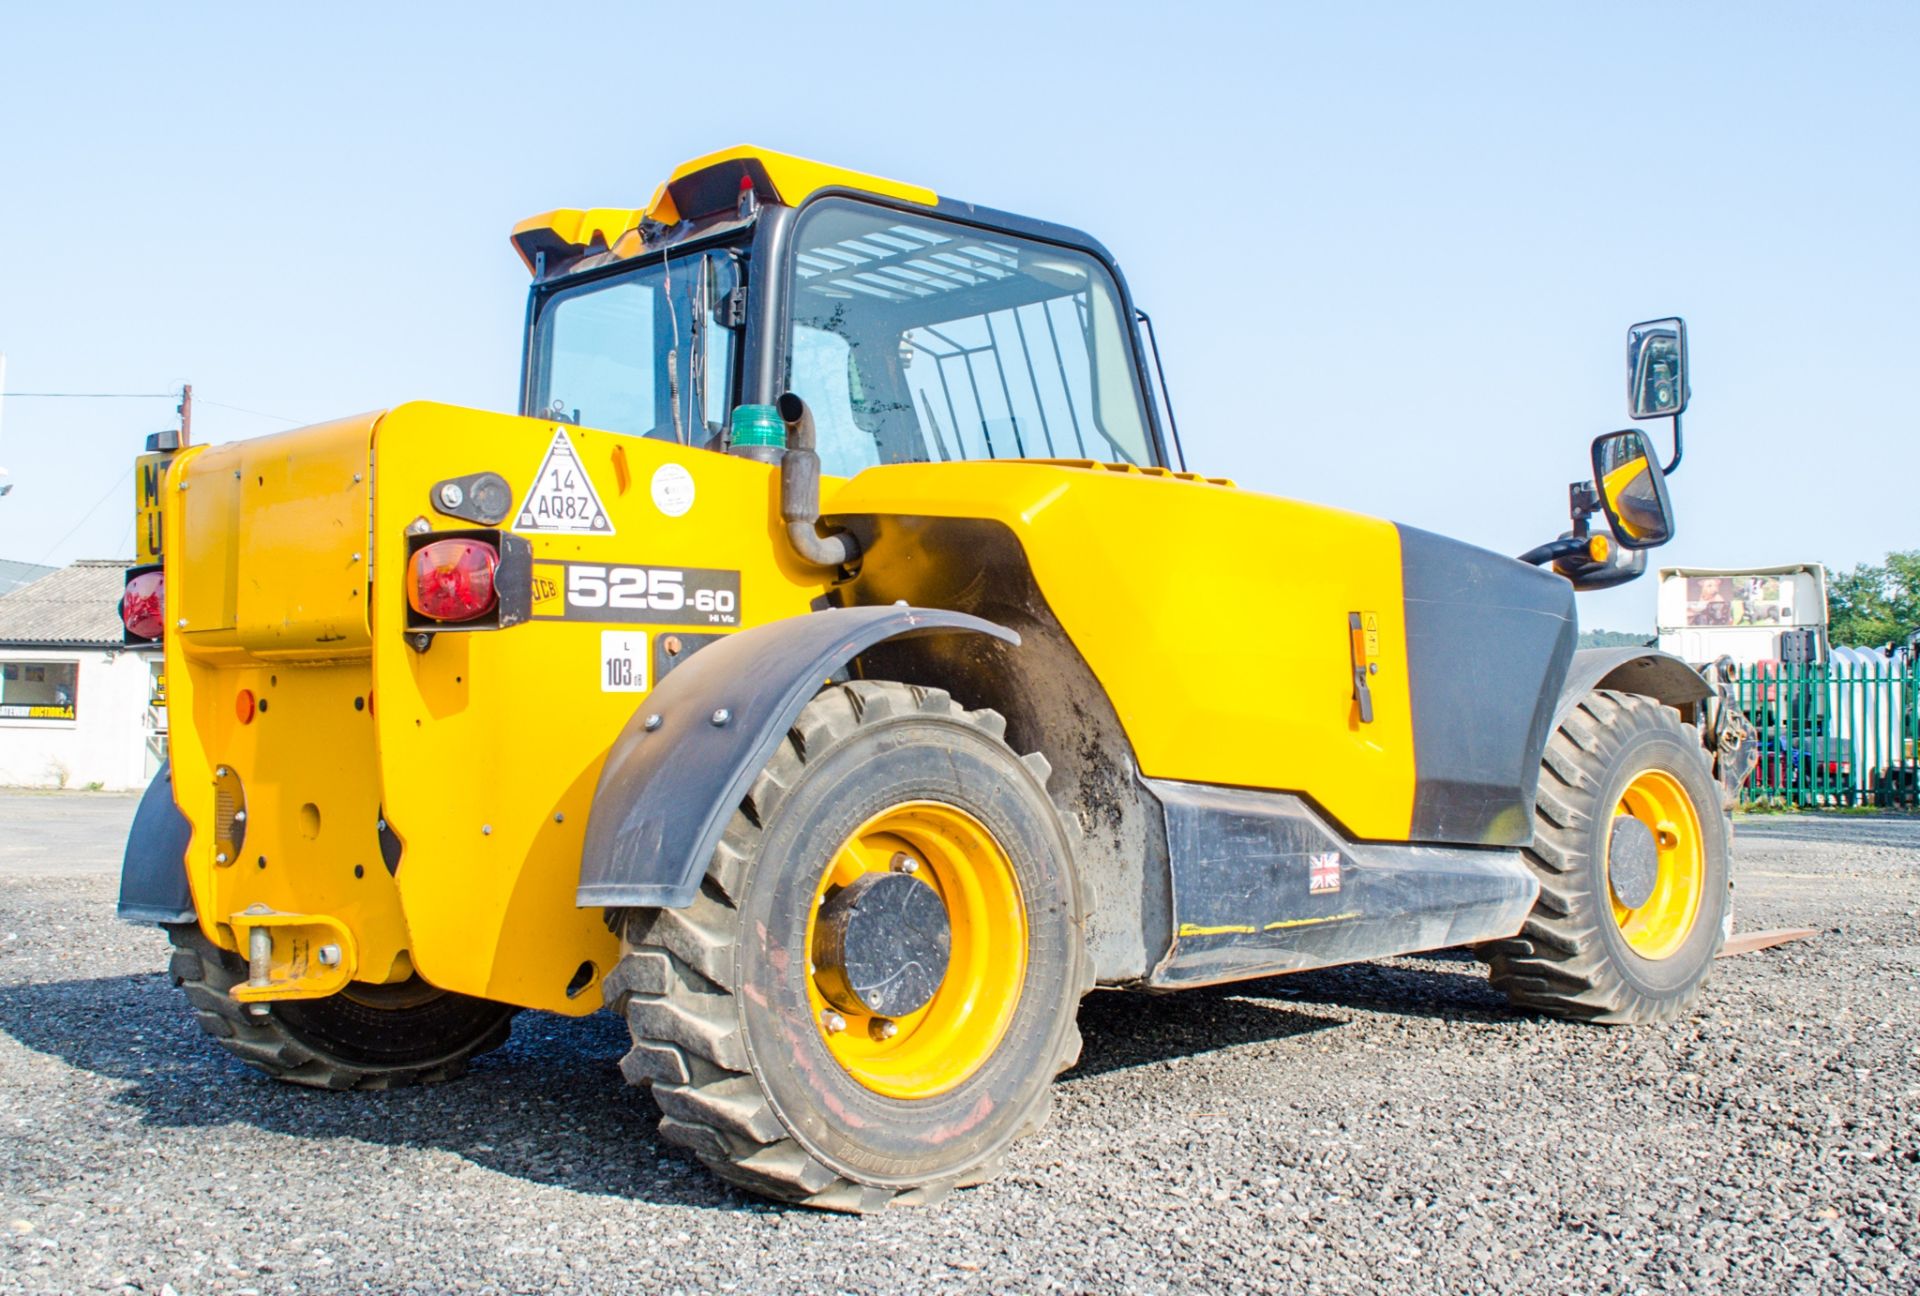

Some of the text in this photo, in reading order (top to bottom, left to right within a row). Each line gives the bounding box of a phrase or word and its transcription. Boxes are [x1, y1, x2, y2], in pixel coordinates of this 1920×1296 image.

[551, 469, 575, 492] 14
[538, 495, 590, 519] AQ8Z
[533, 578, 556, 600] JCB
[708, 613, 720, 623] Hi
[606, 658, 632, 686] 103
